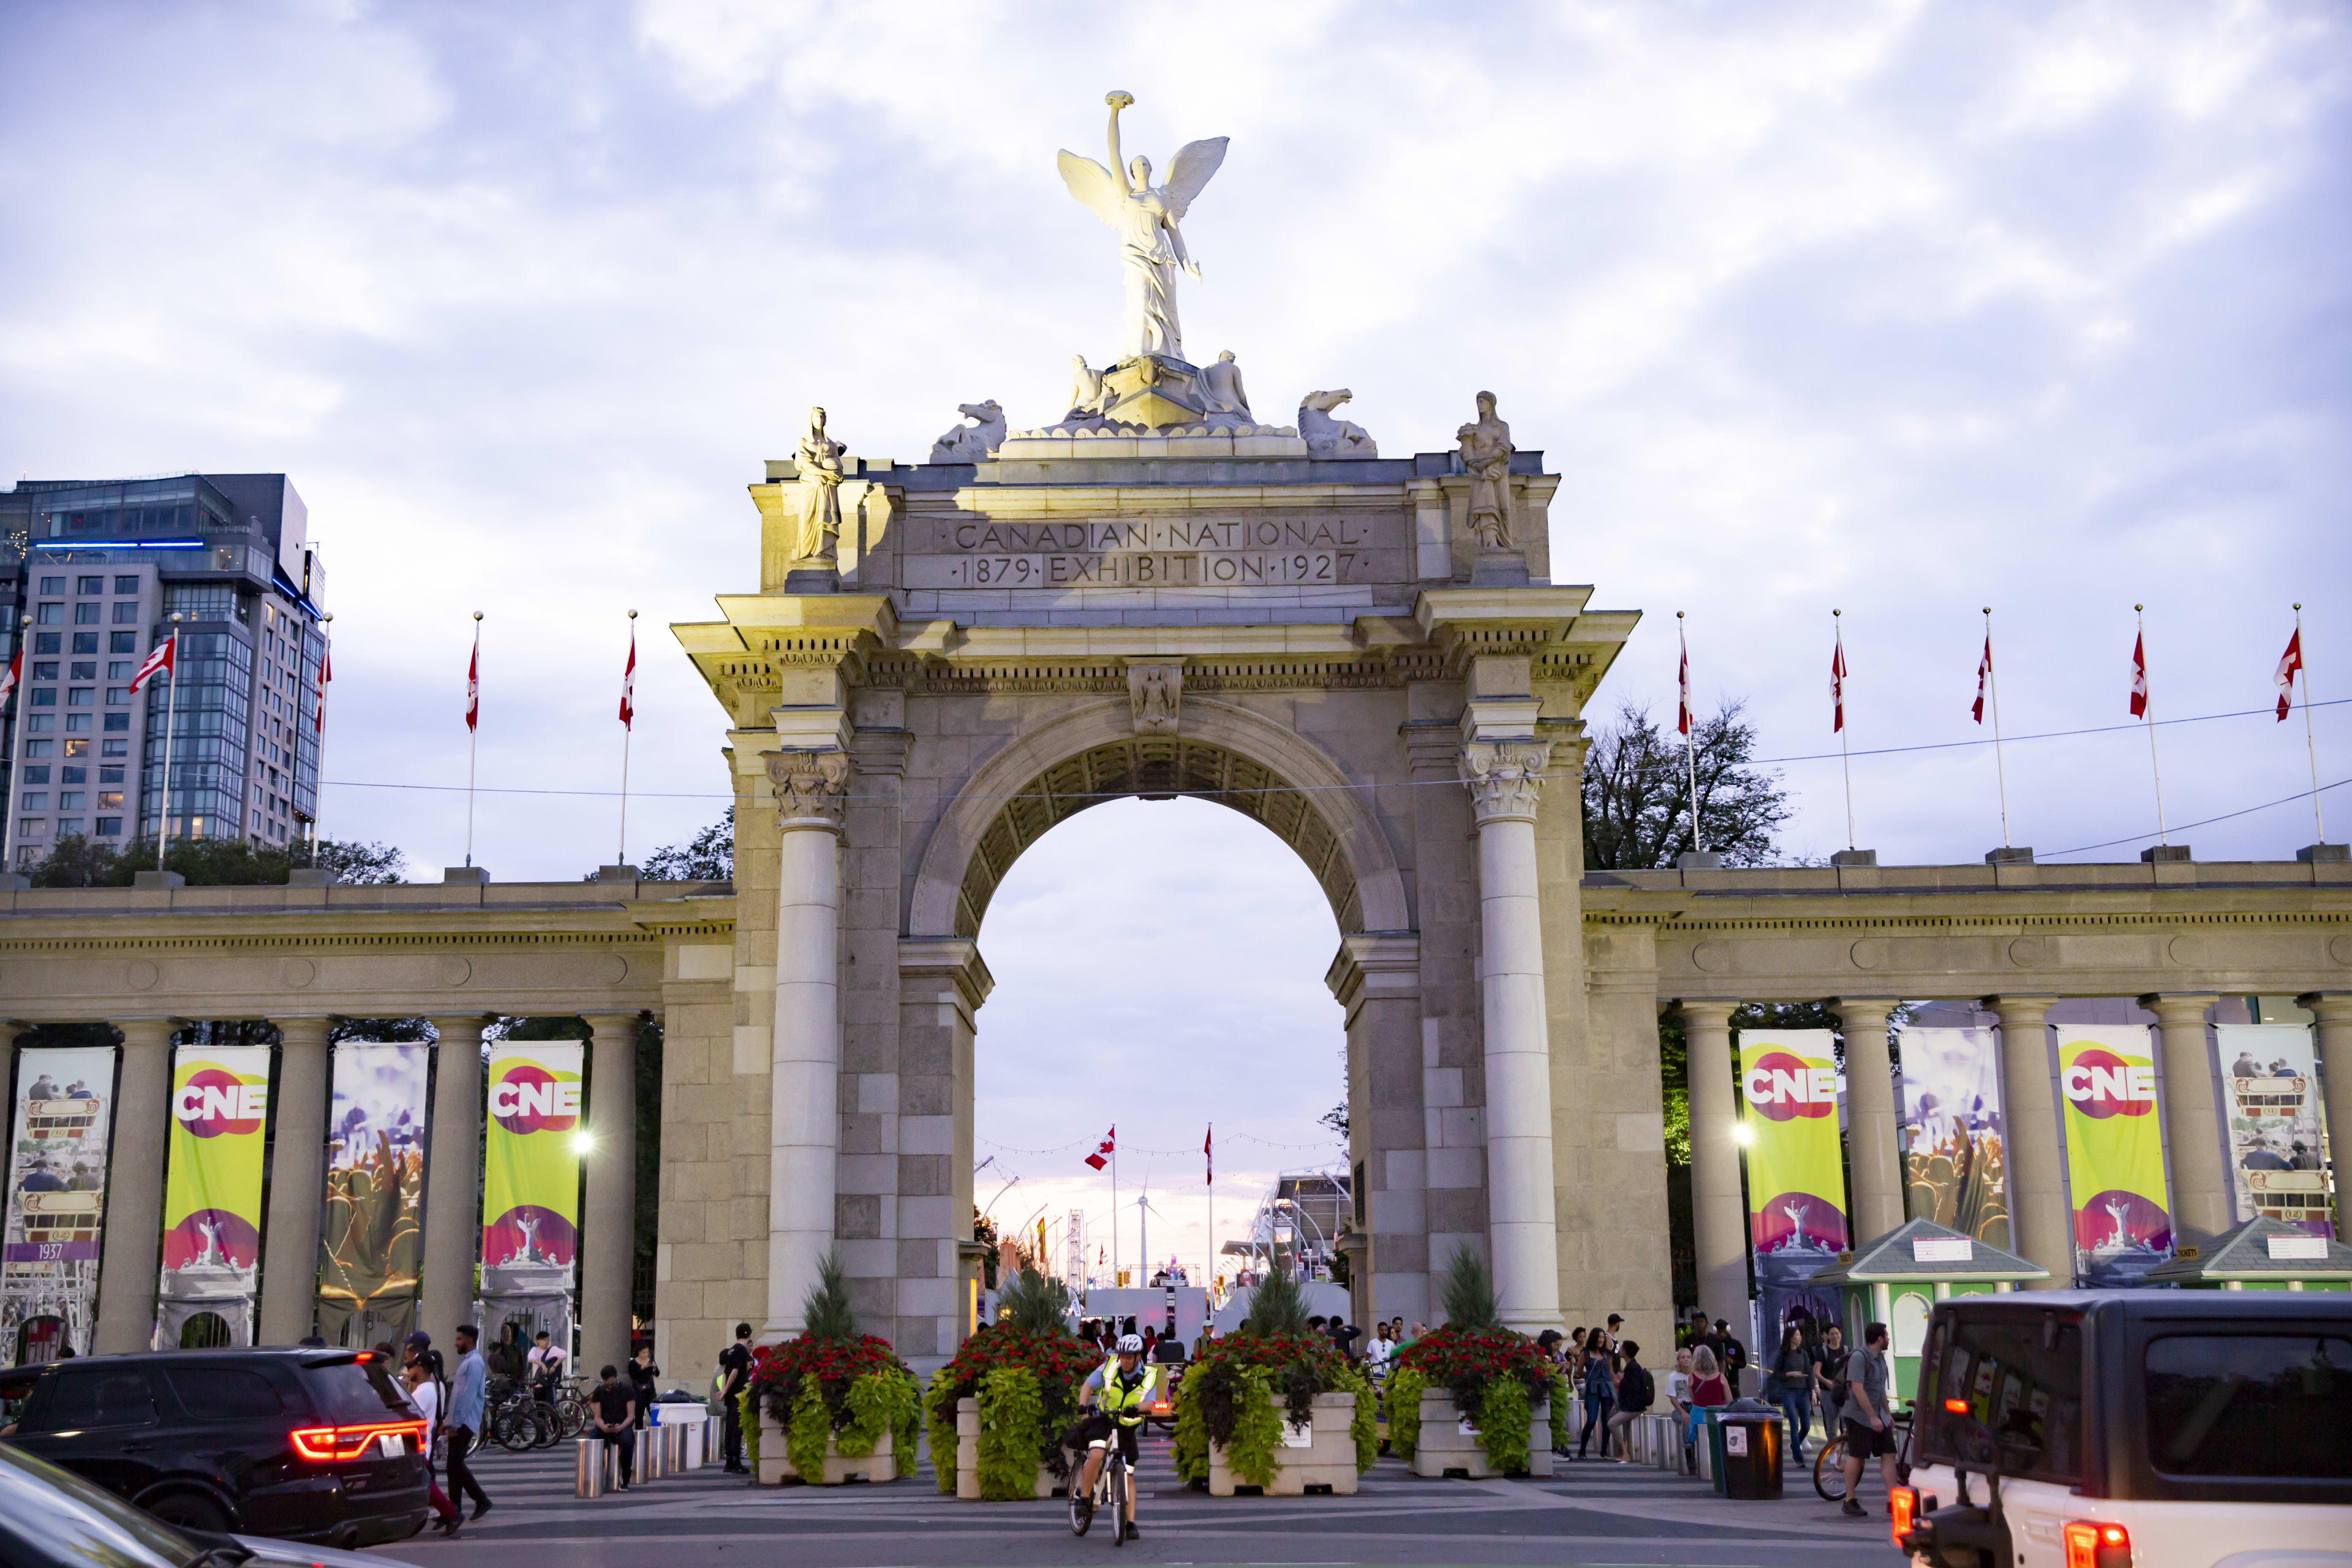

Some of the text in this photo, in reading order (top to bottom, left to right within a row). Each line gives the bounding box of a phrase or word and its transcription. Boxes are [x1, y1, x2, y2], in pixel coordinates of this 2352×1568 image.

[955, 521, 1359, 549] CANADIAN NATIONAL
[961, 553, 1356, 583] 1879 EXHIBITION 1927
[488, 1082, 582, 1117] CNE
[1742, 1068, 1838, 1104] CNE
[2061, 1065, 2157, 1101] CNE
[172, 1085, 268, 1121] CNE
[39, 1243, 63, 1260] 1937
